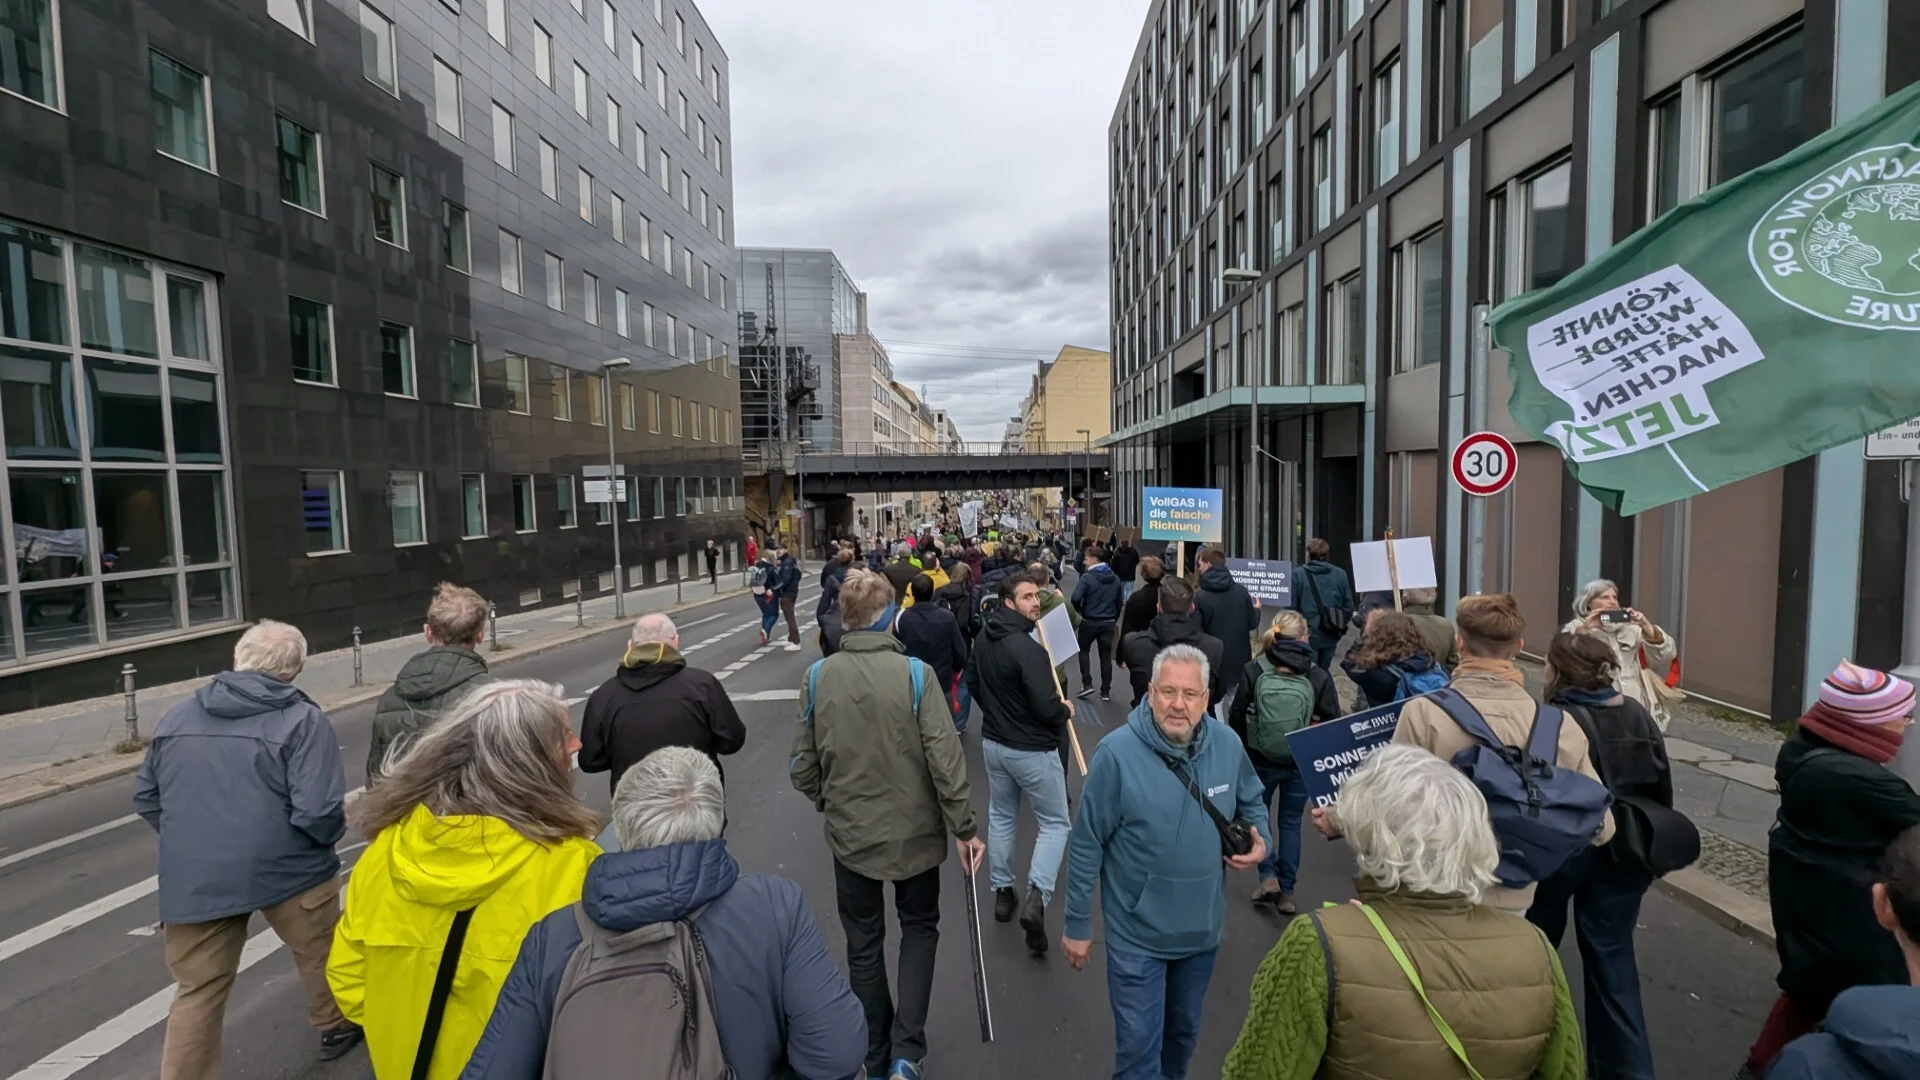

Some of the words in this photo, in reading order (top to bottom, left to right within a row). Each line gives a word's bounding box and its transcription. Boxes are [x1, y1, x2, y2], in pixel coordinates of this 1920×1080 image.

[1466, 450, 1503, 477] 30
[1150, 496, 1196, 508] VollGAS
[1198, 498, 1209, 508] in
[1149, 508, 1167, 518] die
[1170, 509, 1212, 520] falsche
[1149, 520, 1201, 534] Richtung
[1370, 712, 1397, 728] BWE
[1313, 746, 1368, 772] SONNE
